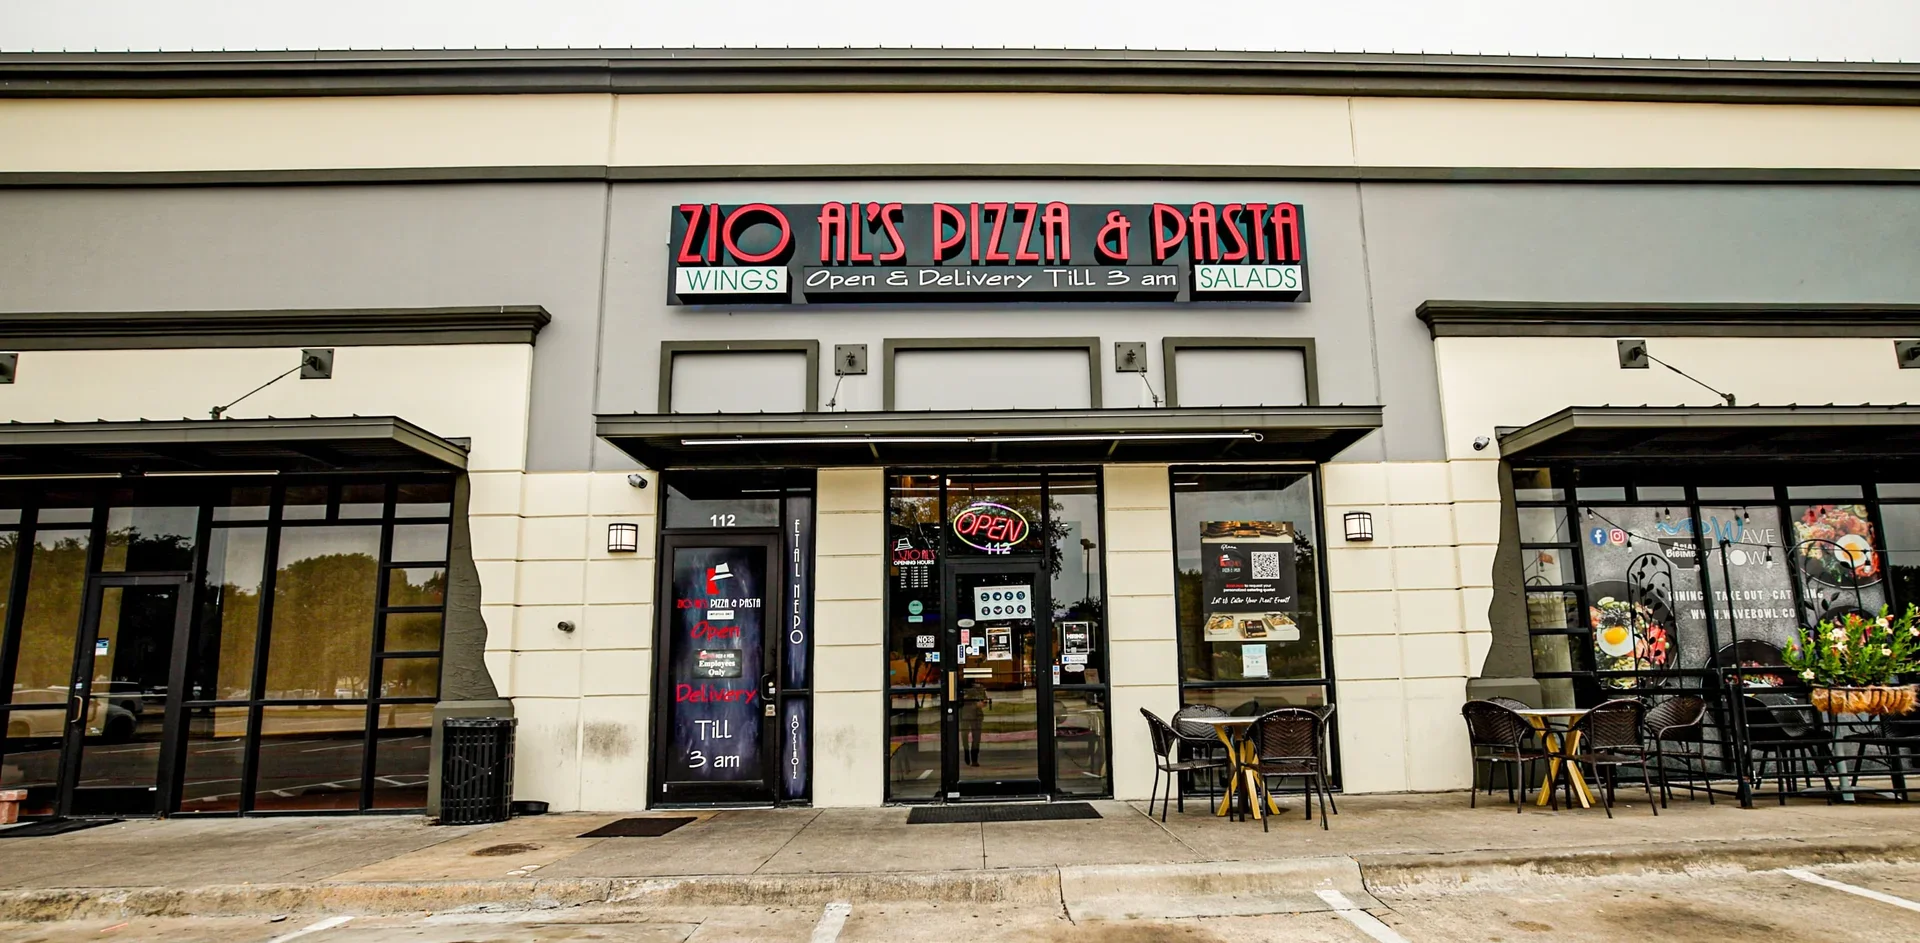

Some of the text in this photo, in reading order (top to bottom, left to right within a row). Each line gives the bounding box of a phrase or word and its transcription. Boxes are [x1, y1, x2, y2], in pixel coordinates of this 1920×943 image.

[677, 201, 1301, 263] ZIO AL'S PIZZA & PASTA
[685, 269, 779, 291] WINGS
[805, 268, 1177, 290] Open & Delivery Till 3 am
[1200, 267, 1298, 289] SALADS
[710, 514, 736, 527] 112
[957, 512, 1024, 542] OPEN
[1710, 516, 1777, 544] WAVE
[985, 542, 1011, 555] 112
[1665, 548, 1709, 558] BIBIMB
[710, 598, 729, 608] PIZZA
[739, 598, 761, 608] PASTA
[1744, 590, 1762, 601] OUT
[1772, 588, 1824, 600] CATING
[1690, 608, 1796, 620] WWW.WAVEBOWL.CO
[690, 620, 741, 642] Open
[698, 660, 736, 668] Employees
[708, 668, 726, 677] Only
[676, 683, 758, 705] Delivery
[694, 719, 732, 741] Till
[688, 750, 740, 768] 3 am
